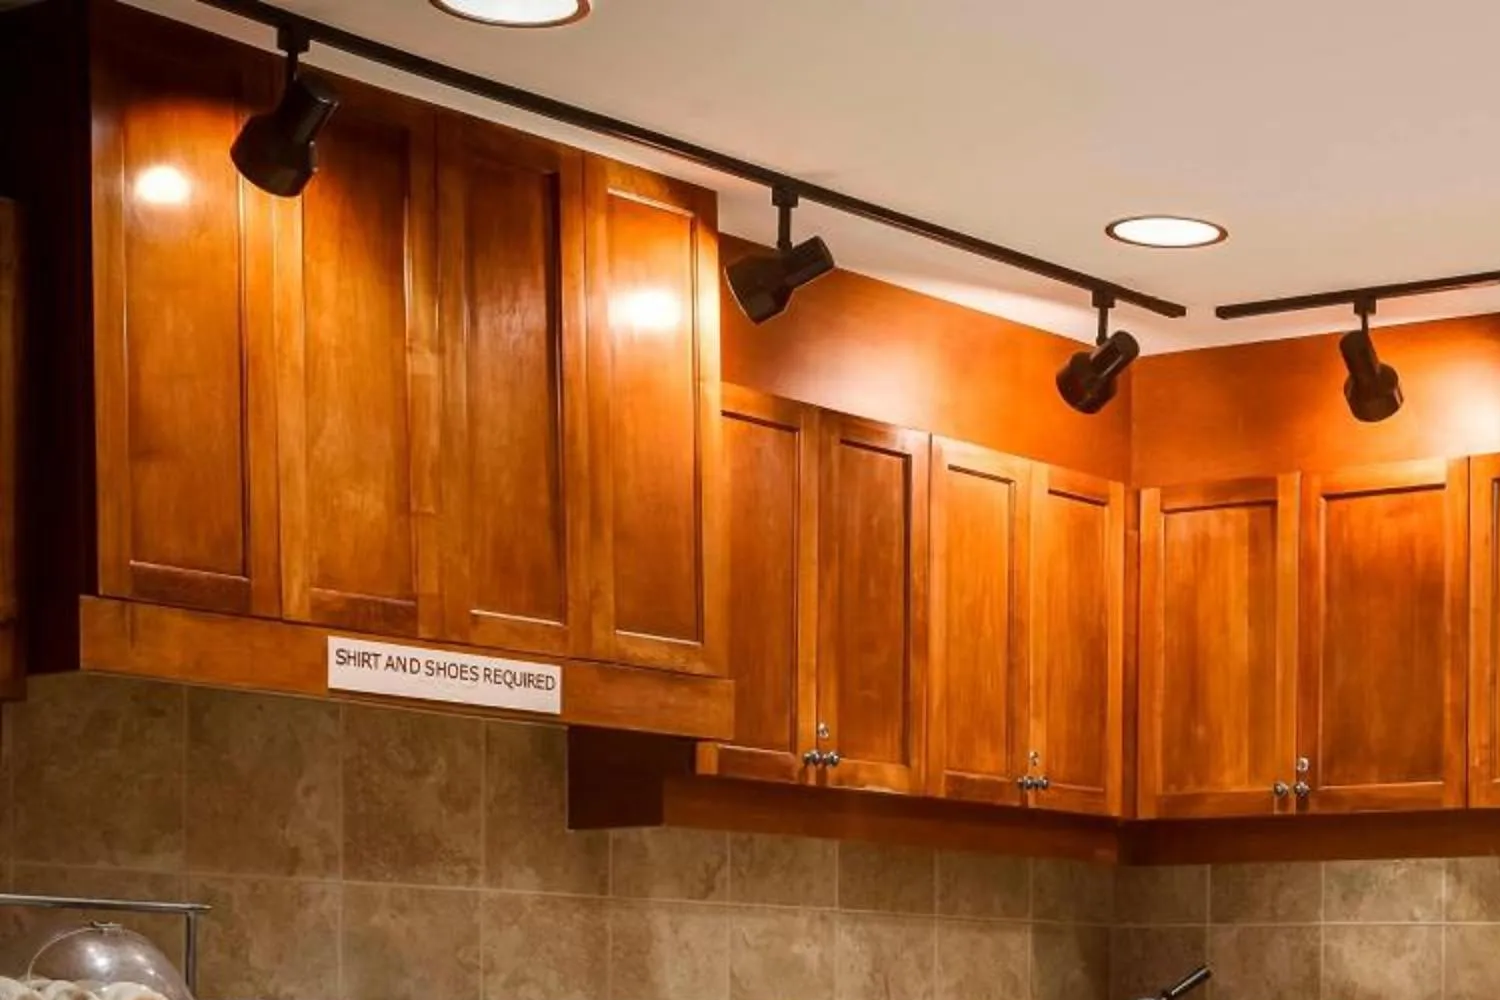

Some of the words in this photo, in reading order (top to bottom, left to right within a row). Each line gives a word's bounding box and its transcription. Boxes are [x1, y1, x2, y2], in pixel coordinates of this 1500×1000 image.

[335, 648, 382, 671] SHIRT
[385, 655, 421, 675] AND
[425, 659, 480, 683] SHOES
[483, 667, 556, 691] REQUIRED
